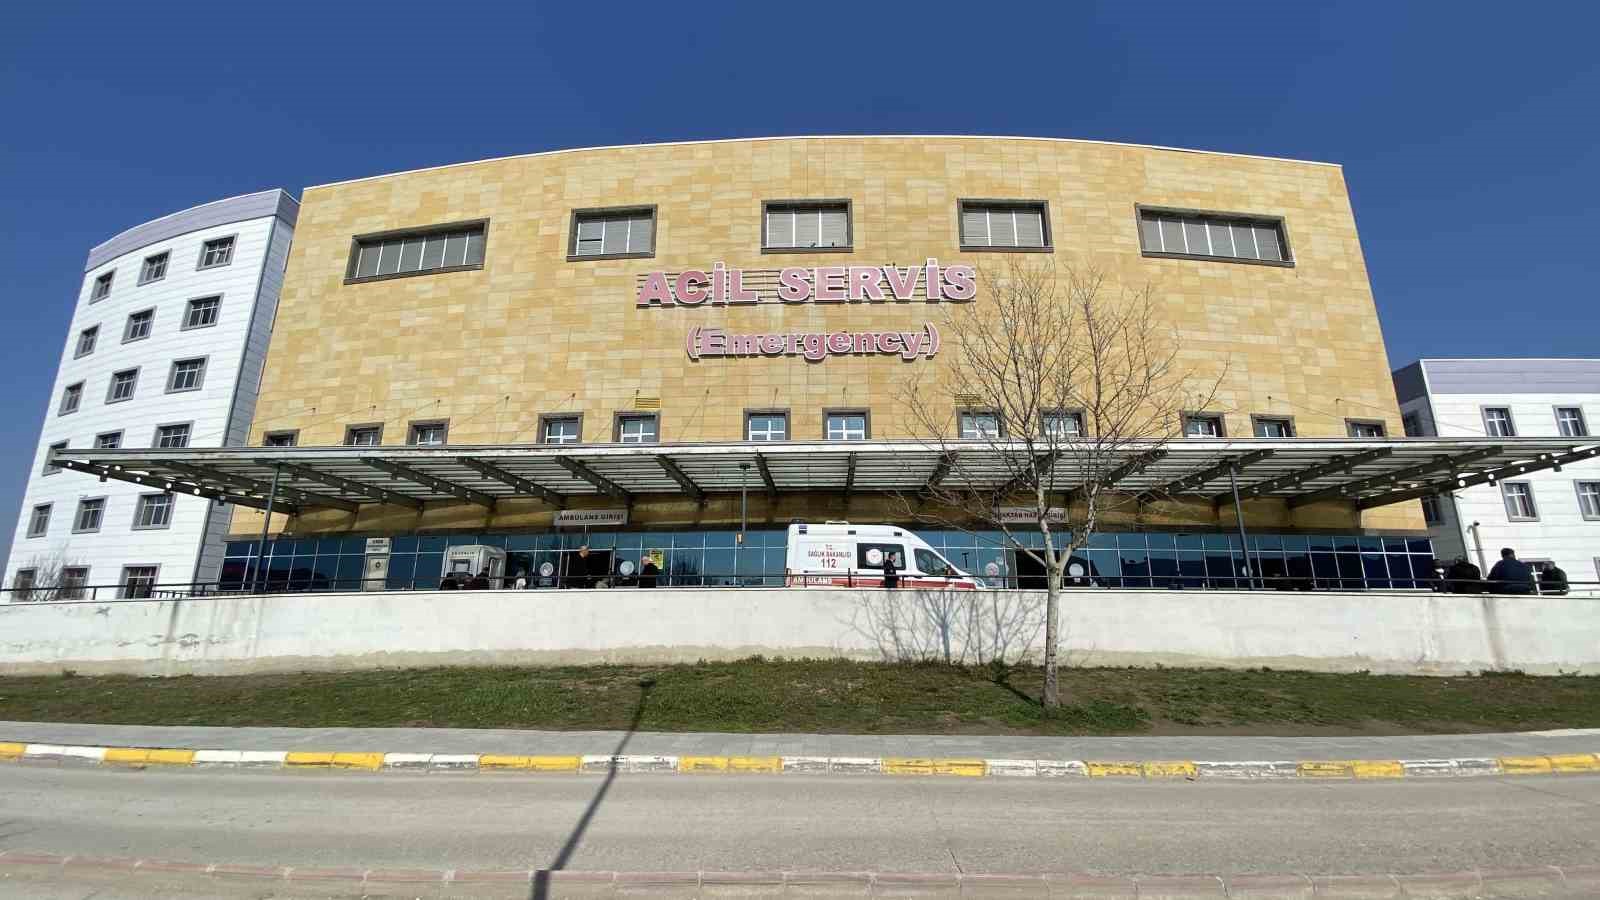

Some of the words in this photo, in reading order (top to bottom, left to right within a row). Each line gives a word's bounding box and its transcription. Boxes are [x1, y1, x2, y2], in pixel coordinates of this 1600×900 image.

[637, 261, 759, 304] ACİL
[777, 257, 977, 302] SERVİS
[686, 320, 941, 360] (Emergency)
[821, 558, 837, 568] 112
